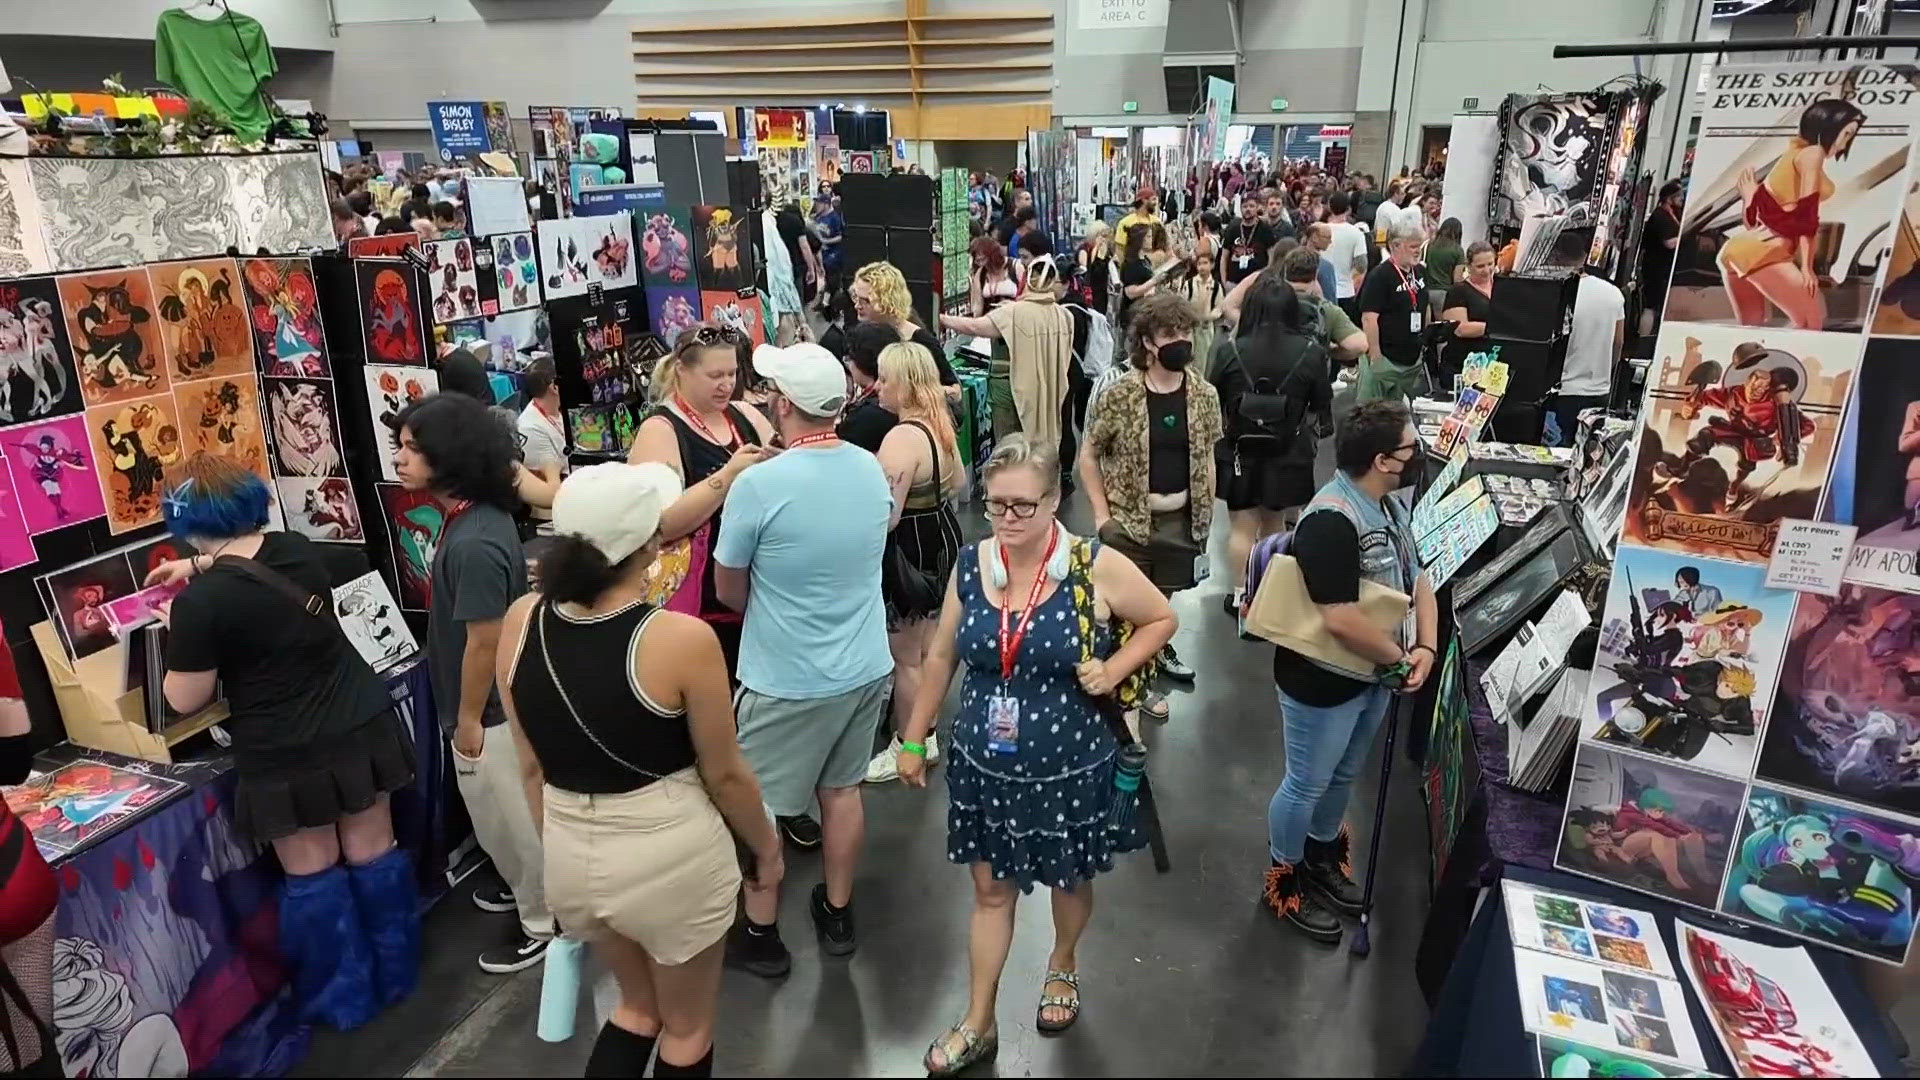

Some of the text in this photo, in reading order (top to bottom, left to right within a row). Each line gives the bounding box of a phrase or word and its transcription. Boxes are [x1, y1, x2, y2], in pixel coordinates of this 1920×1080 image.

[1100, 11, 1146, 21] AREA C
[1716, 73, 1766, 90] THE
[1843, 90, 1914, 105] POST
[439, 105, 472, 118] SIMON
[1811, 527, 1840, 536] PRINTS
[1848, 546, 1877, 569] MY
